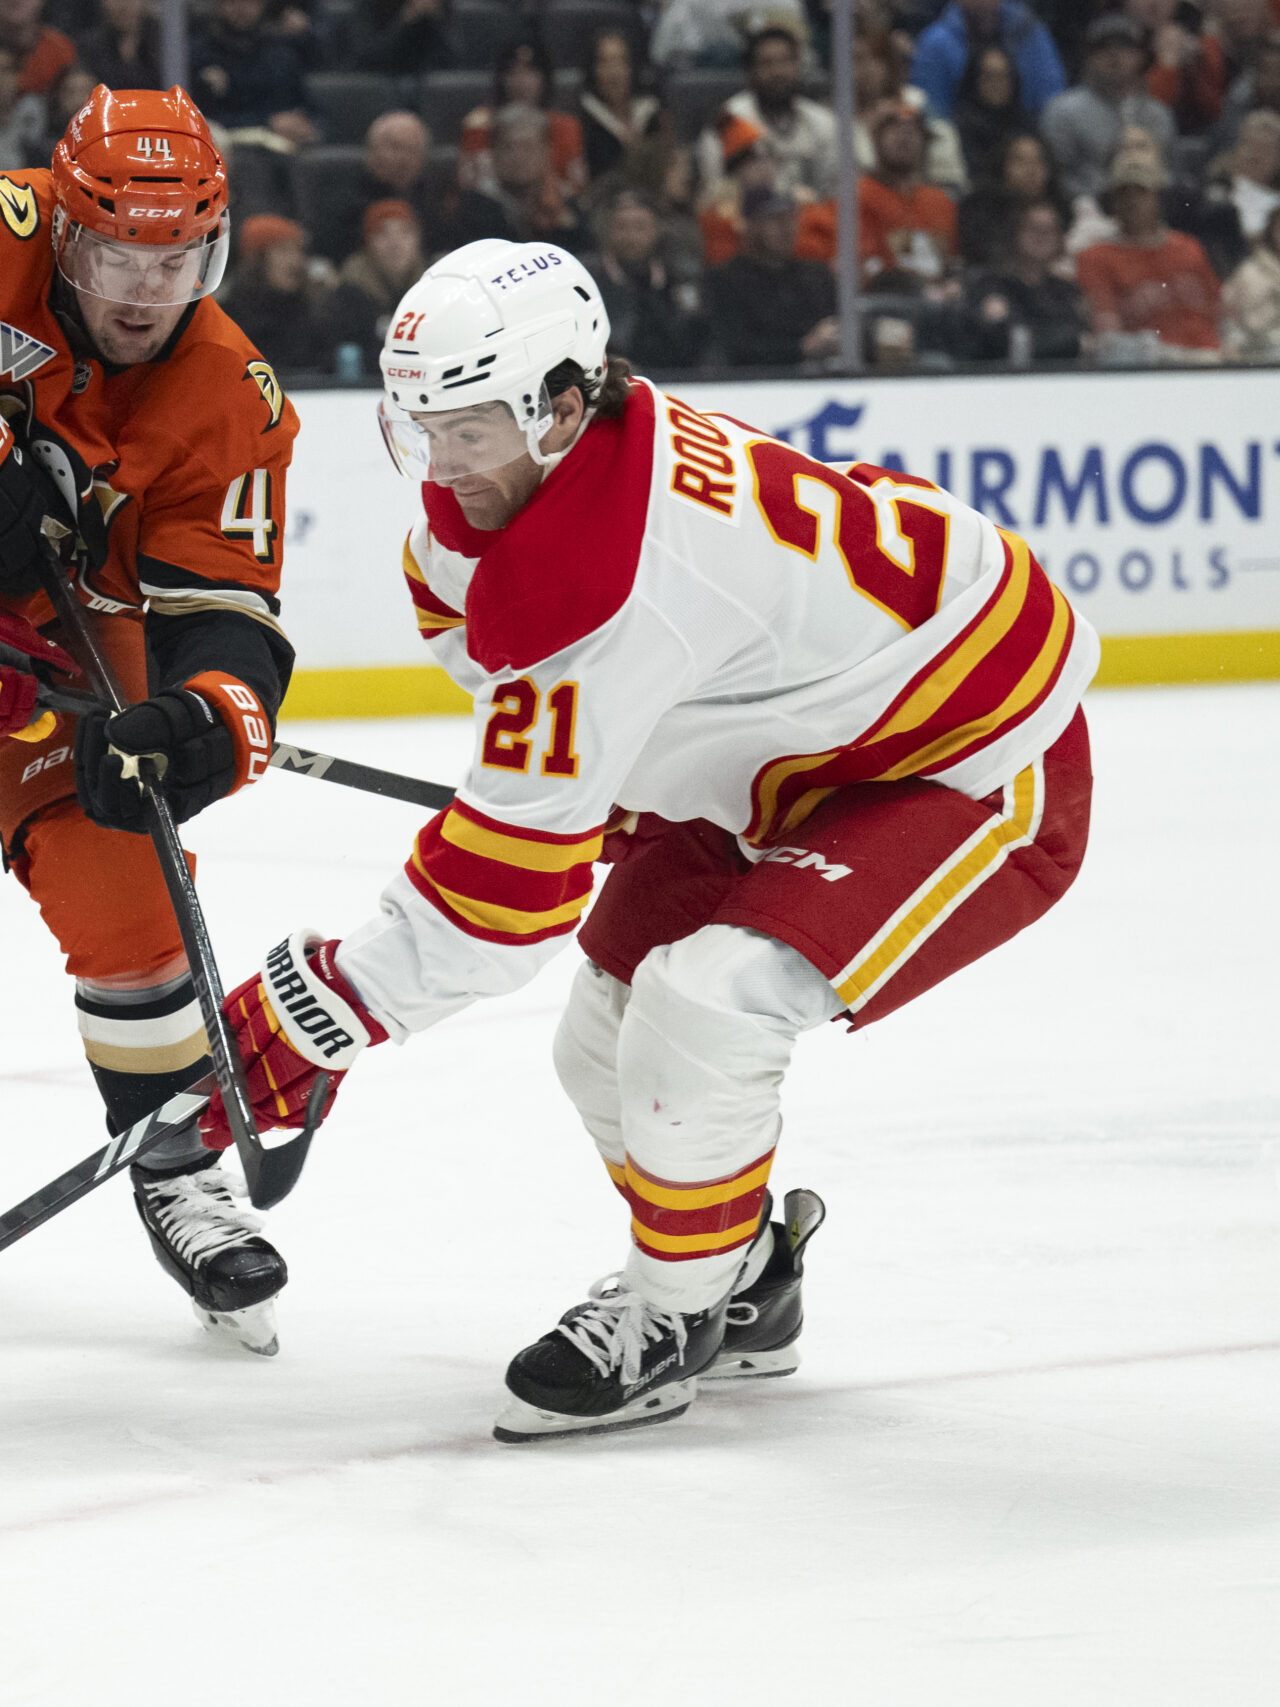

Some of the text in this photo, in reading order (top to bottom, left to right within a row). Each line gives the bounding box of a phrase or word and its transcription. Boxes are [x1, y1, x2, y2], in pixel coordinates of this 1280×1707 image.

[137, 137, 171, 159] 44
[128, 207, 183, 218] CCM
[490, 252, 563, 289] TELUS
[392, 312, 426, 342] 21
[387, 367, 422, 379] CCM
[1039, 547, 1231, 592] OOLS
[220, 684, 269, 790] BAU
[481, 675, 580, 779] 21
[763, 845, 854, 882] CM
[266, 933, 355, 1059] ARRIOR
